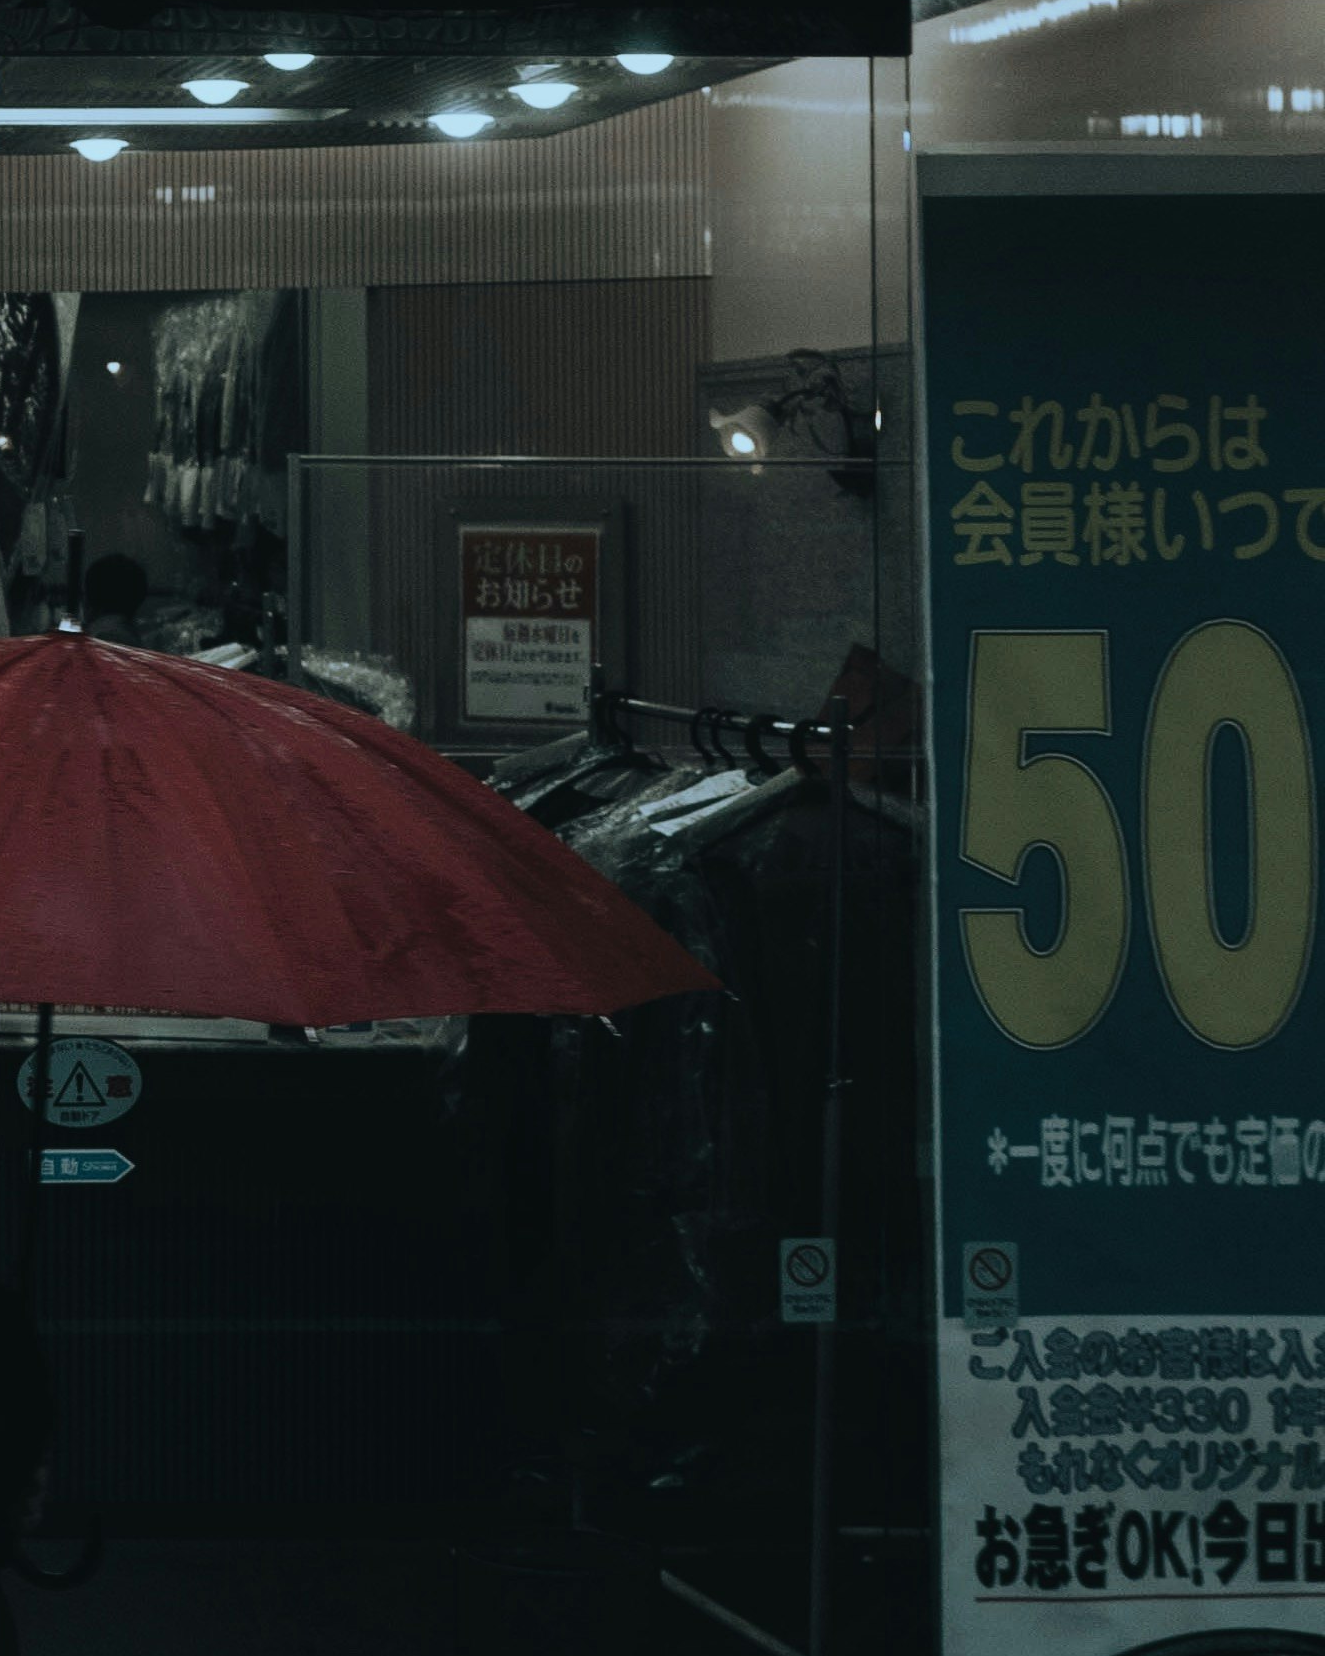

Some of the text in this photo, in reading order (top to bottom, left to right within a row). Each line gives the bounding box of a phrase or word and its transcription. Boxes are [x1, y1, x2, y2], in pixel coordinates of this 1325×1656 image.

[952, 392, 1268, 473] これからは
[474, 541, 583, 574] 定休日の
[477, 576, 582, 610] お知らせ
[959, 617, 1319, 1050] 50
